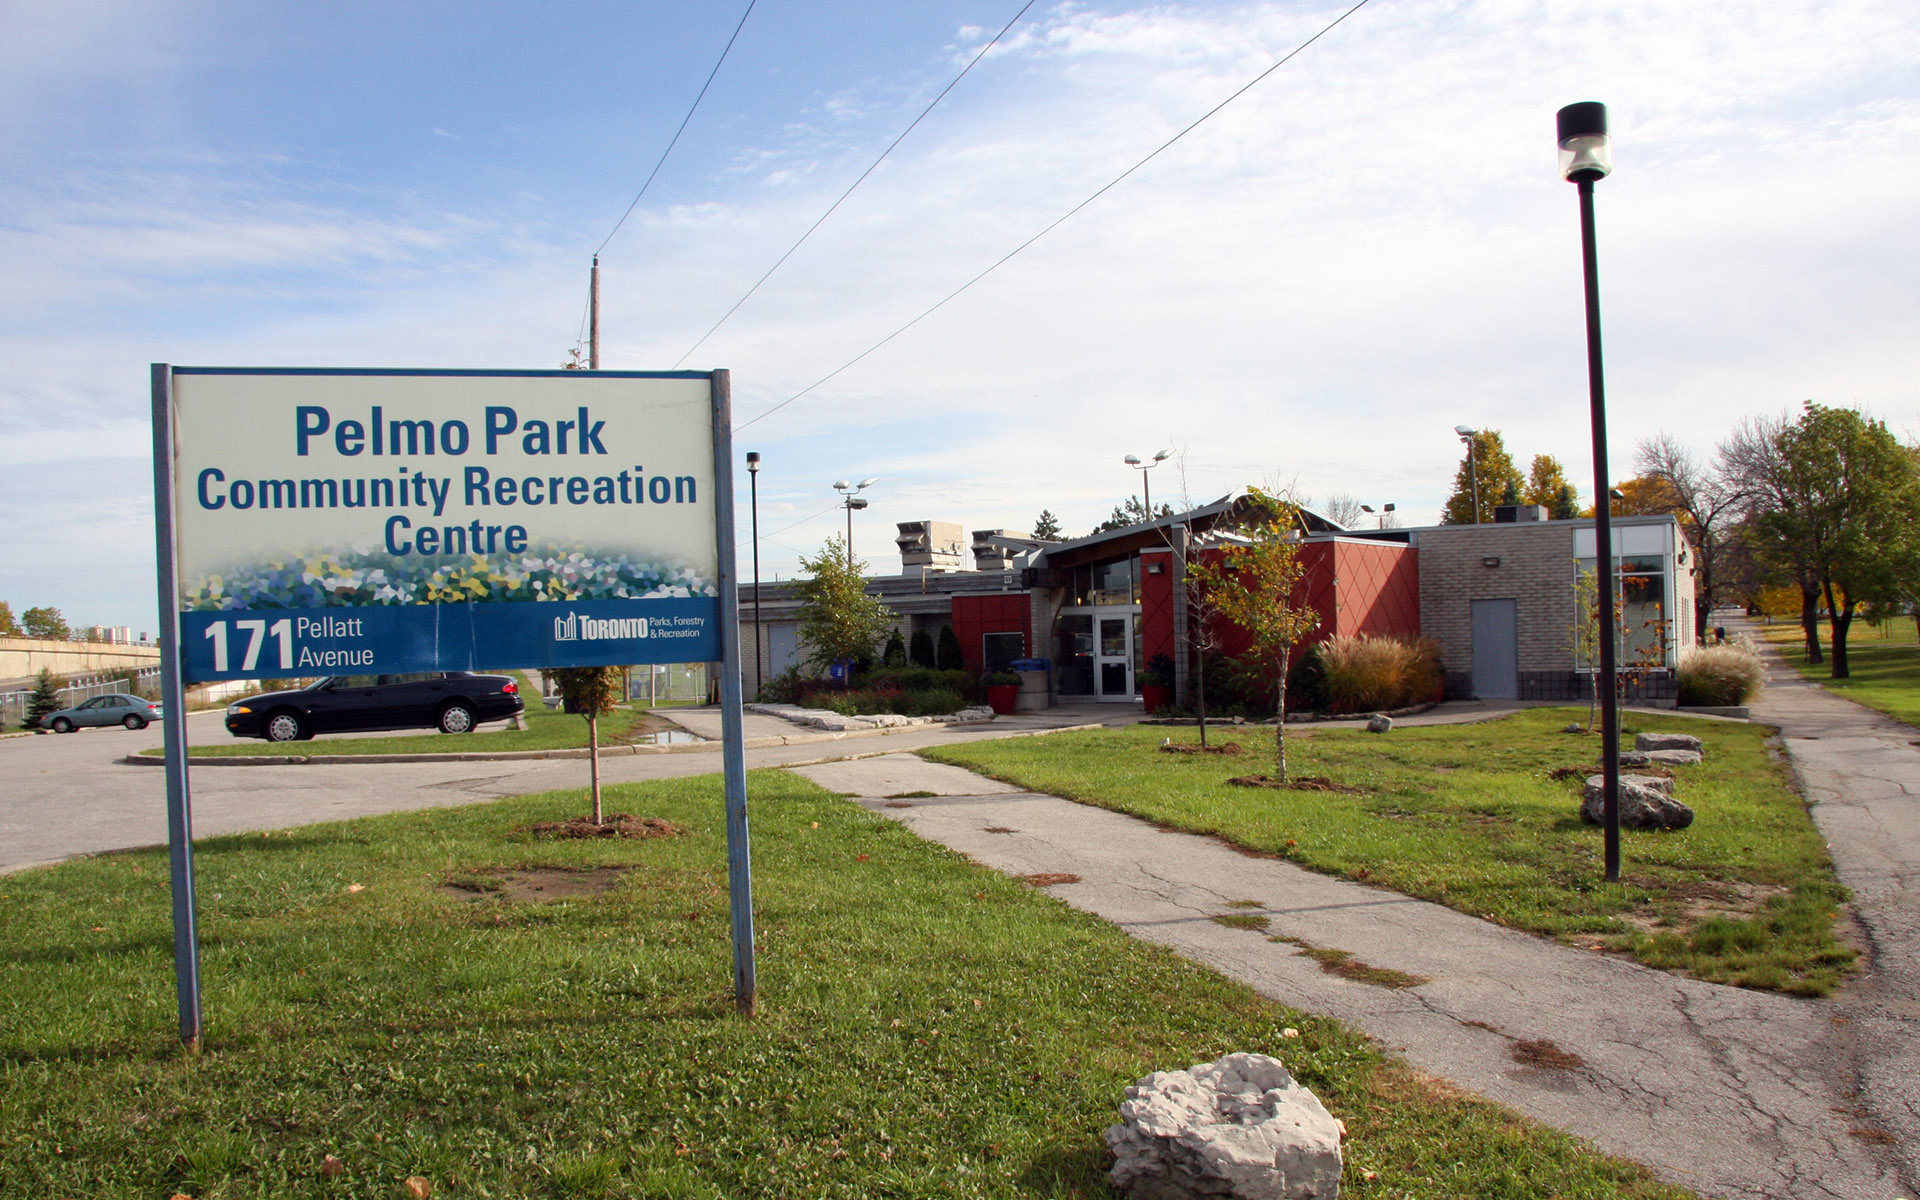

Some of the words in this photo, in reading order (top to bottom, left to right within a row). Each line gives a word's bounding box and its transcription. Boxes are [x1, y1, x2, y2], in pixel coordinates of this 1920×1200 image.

[296, 405, 469, 456] Pelmo
[485, 406, 608, 456] Park
[198, 467, 452, 516] Community
[464, 464, 697, 506] Recreation
[384, 515, 528, 556] Centre
[298, 616, 363, 639] Pellatt
[578, 615, 648, 640] TORONTO
[649, 617, 673, 627] Parks,
[673, 616, 705, 626] Forestry
[650, 629, 657, 639] &
[658, 628, 700, 639] Recreation
[205, 618, 293, 672] 171
[298, 646, 375, 668] Avenue
